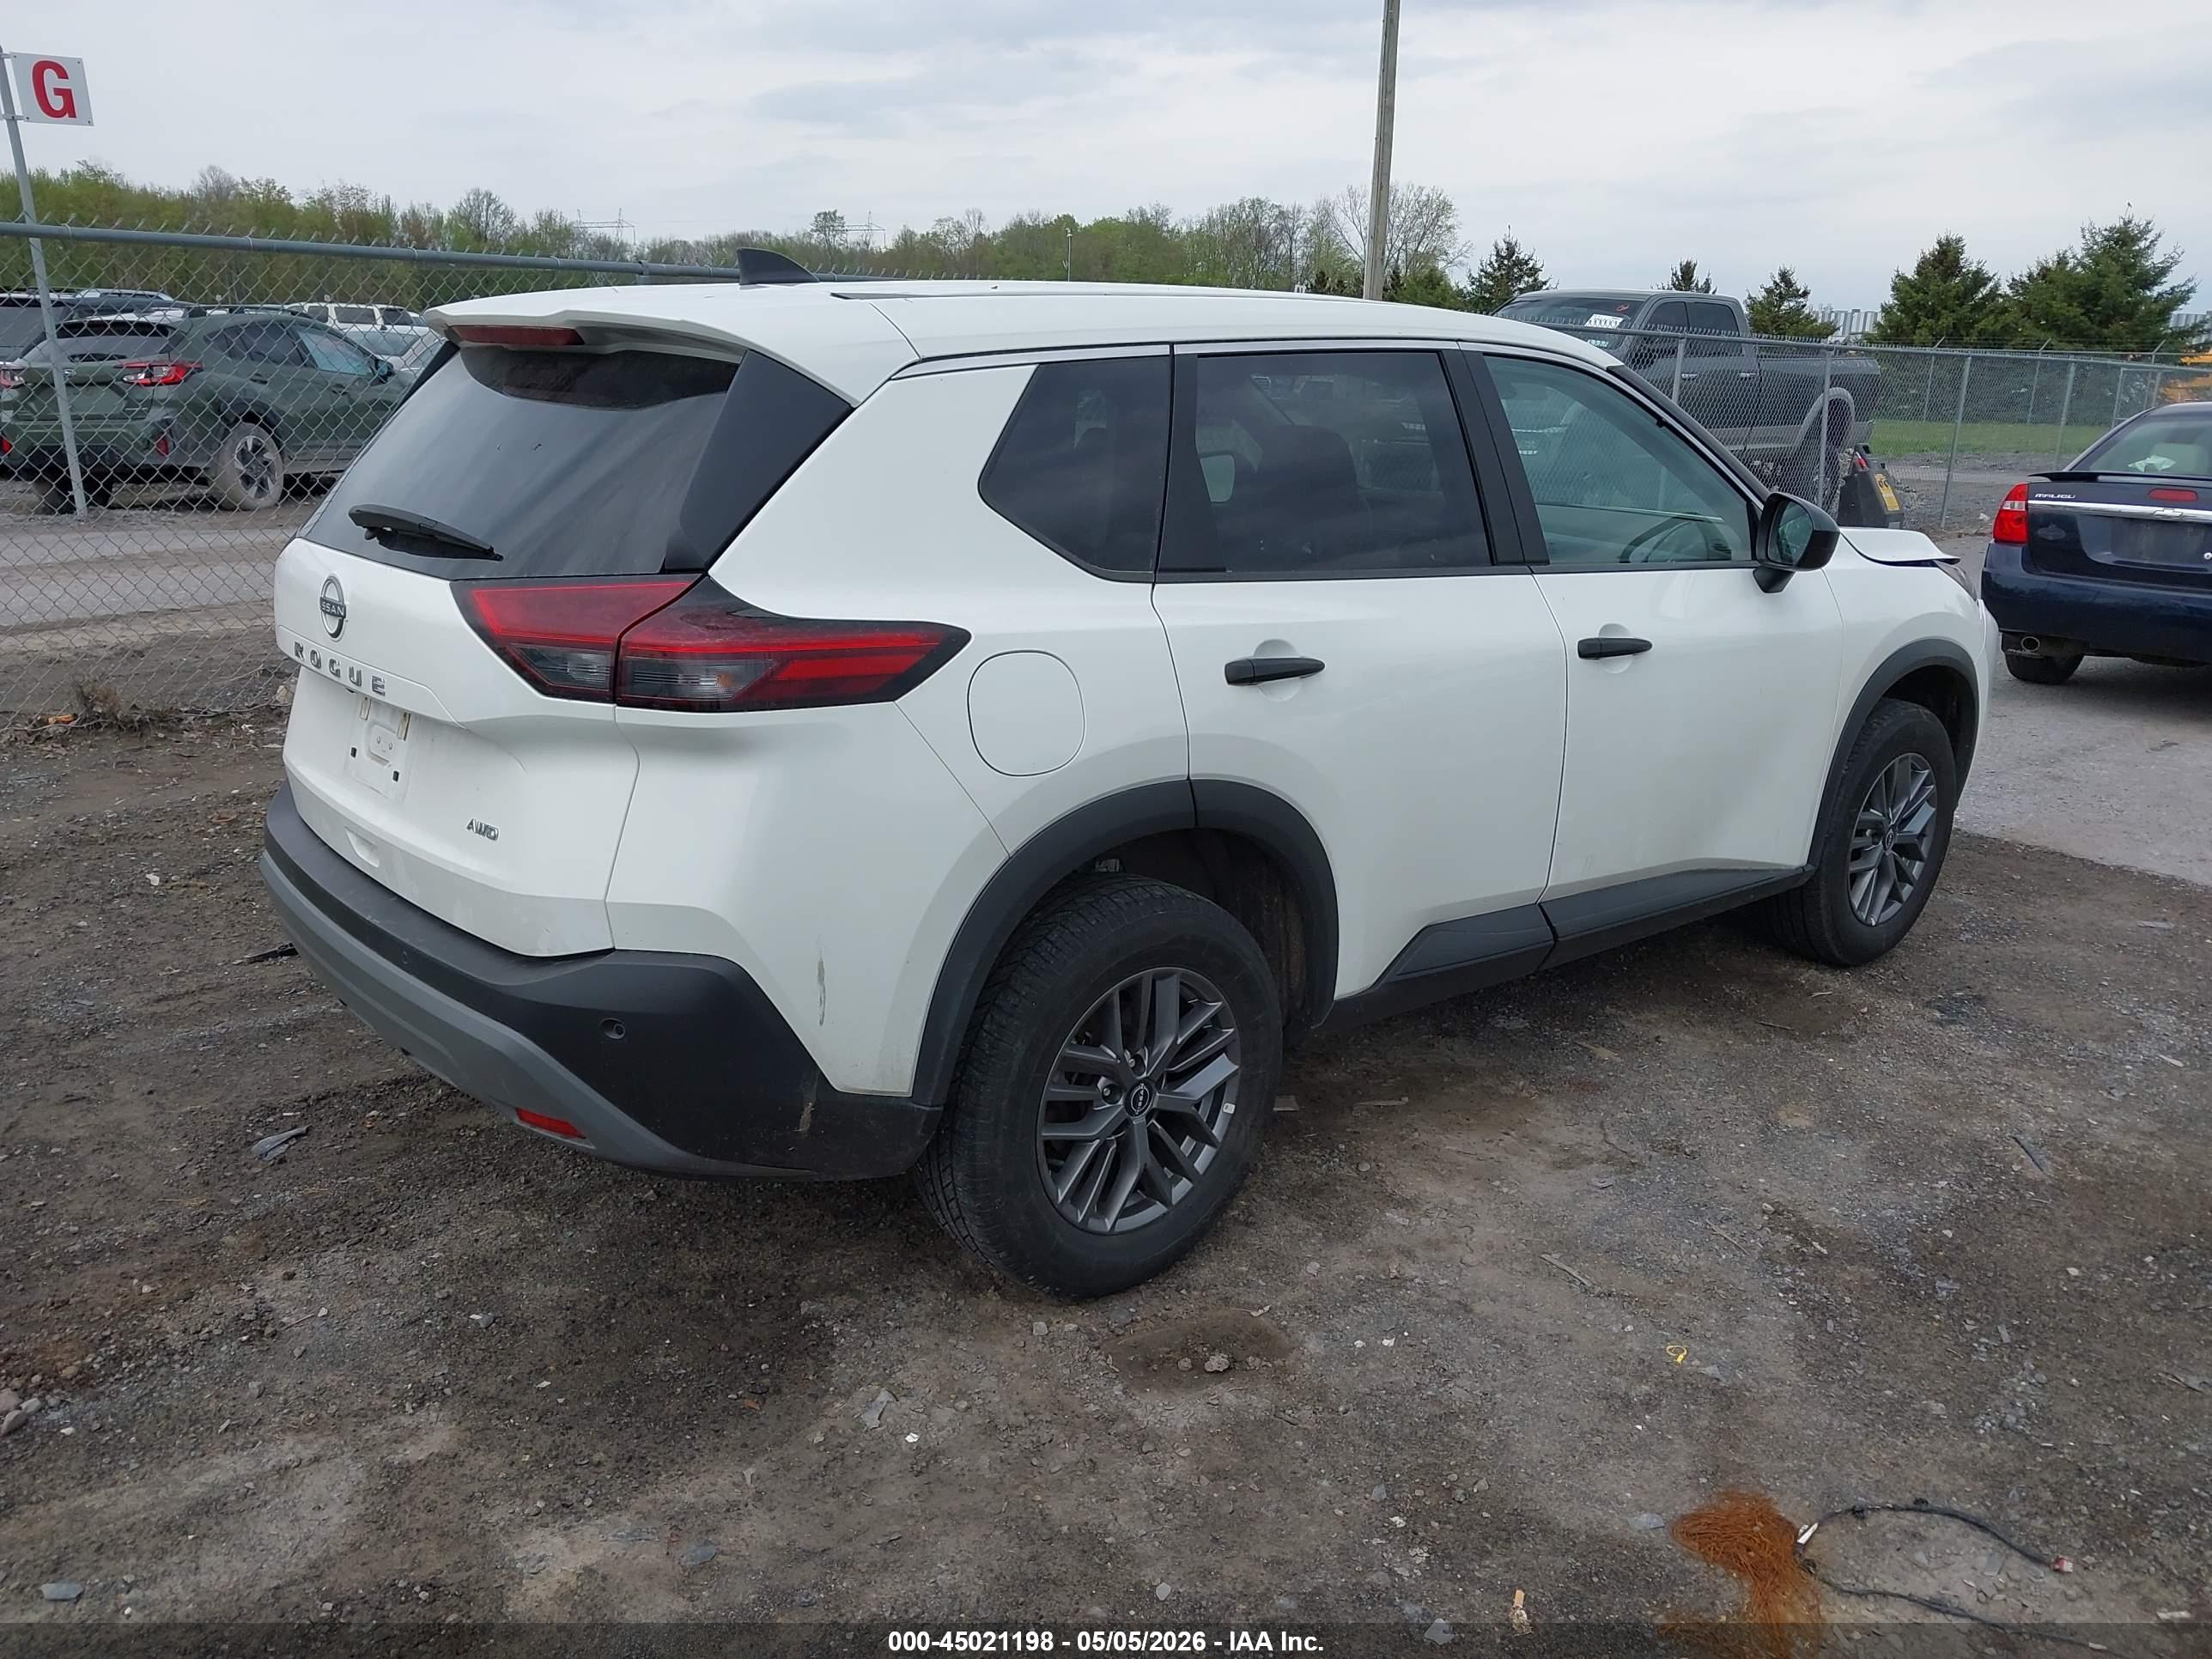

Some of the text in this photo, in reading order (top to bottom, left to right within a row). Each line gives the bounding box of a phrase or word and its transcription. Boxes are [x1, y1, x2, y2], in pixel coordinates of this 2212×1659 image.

[32, 60, 77, 118] G
[294, 641, 386, 697] ROGUE
[466, 817, 499, 842] AWD
